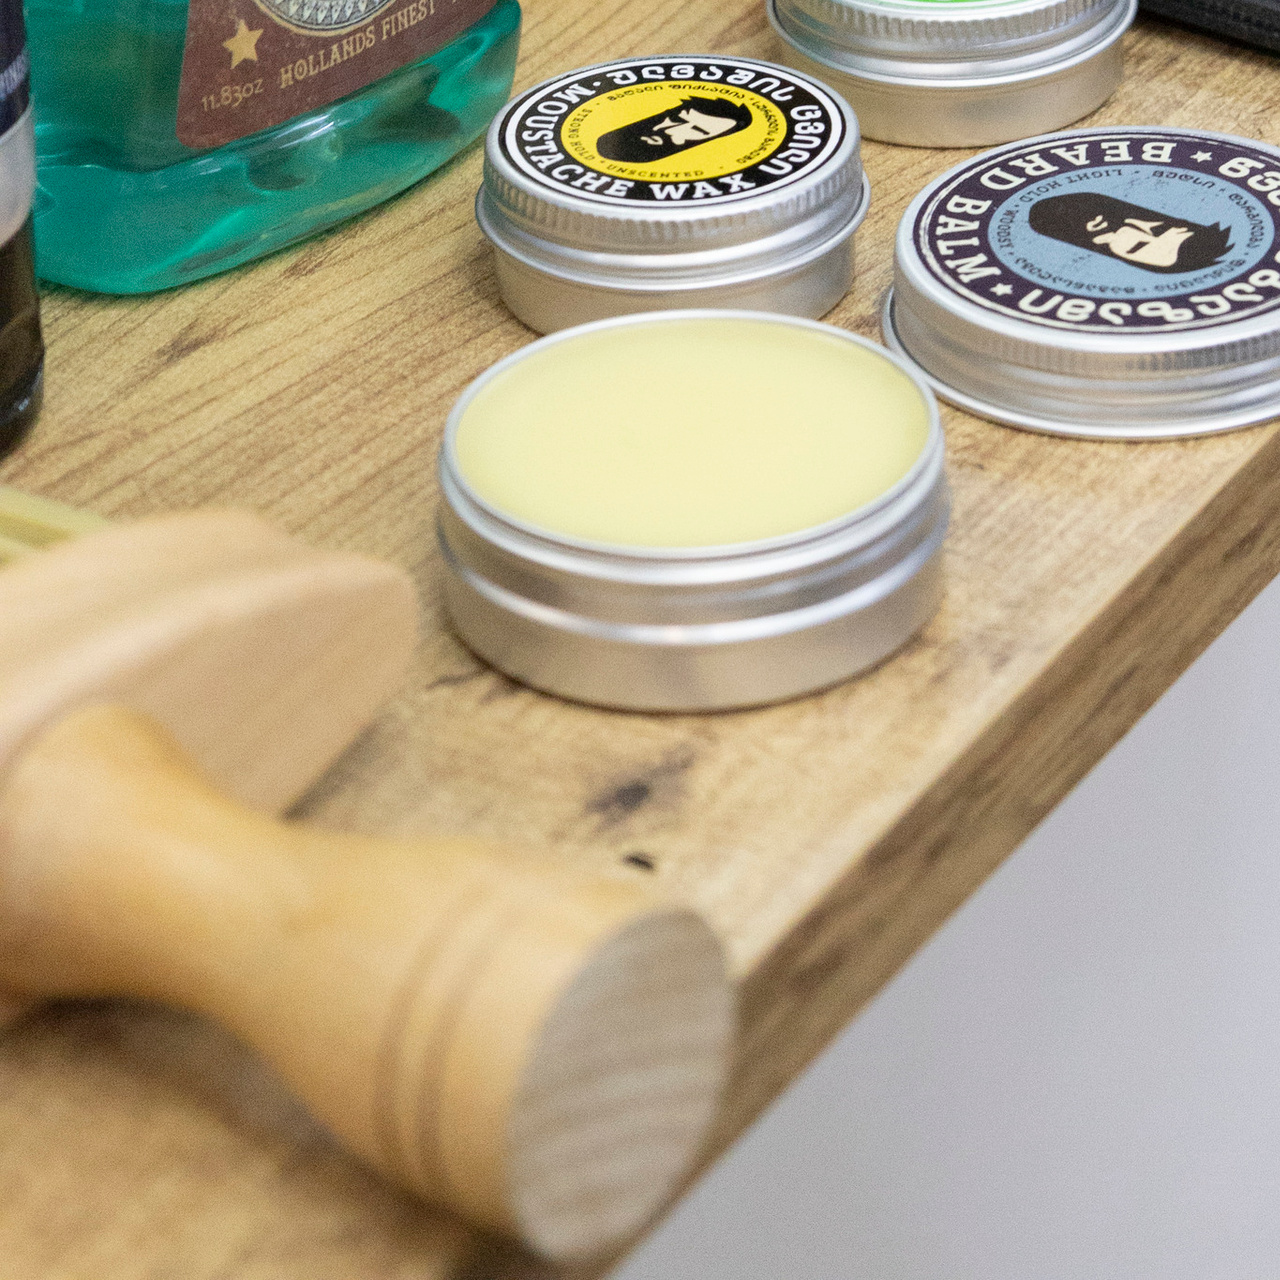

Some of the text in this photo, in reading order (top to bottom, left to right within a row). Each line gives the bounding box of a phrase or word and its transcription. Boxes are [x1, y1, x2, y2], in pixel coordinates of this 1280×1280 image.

[279, 26, 375, 89] HOLLANDS
[521, 83, 757, 200] MOUSTACHE WAX
[568, 107, 595, 162] STRONG HOLD
[606, 64, 826, 176] ულვაშის ცვილი
[606, 163, 705, 178] UNSCENTED
[1020, 179, 1062, 205] HOLD
[1066, 168, 1123, 185] LIGHT
[935, 140, 1178, 285] BEARD BALM
